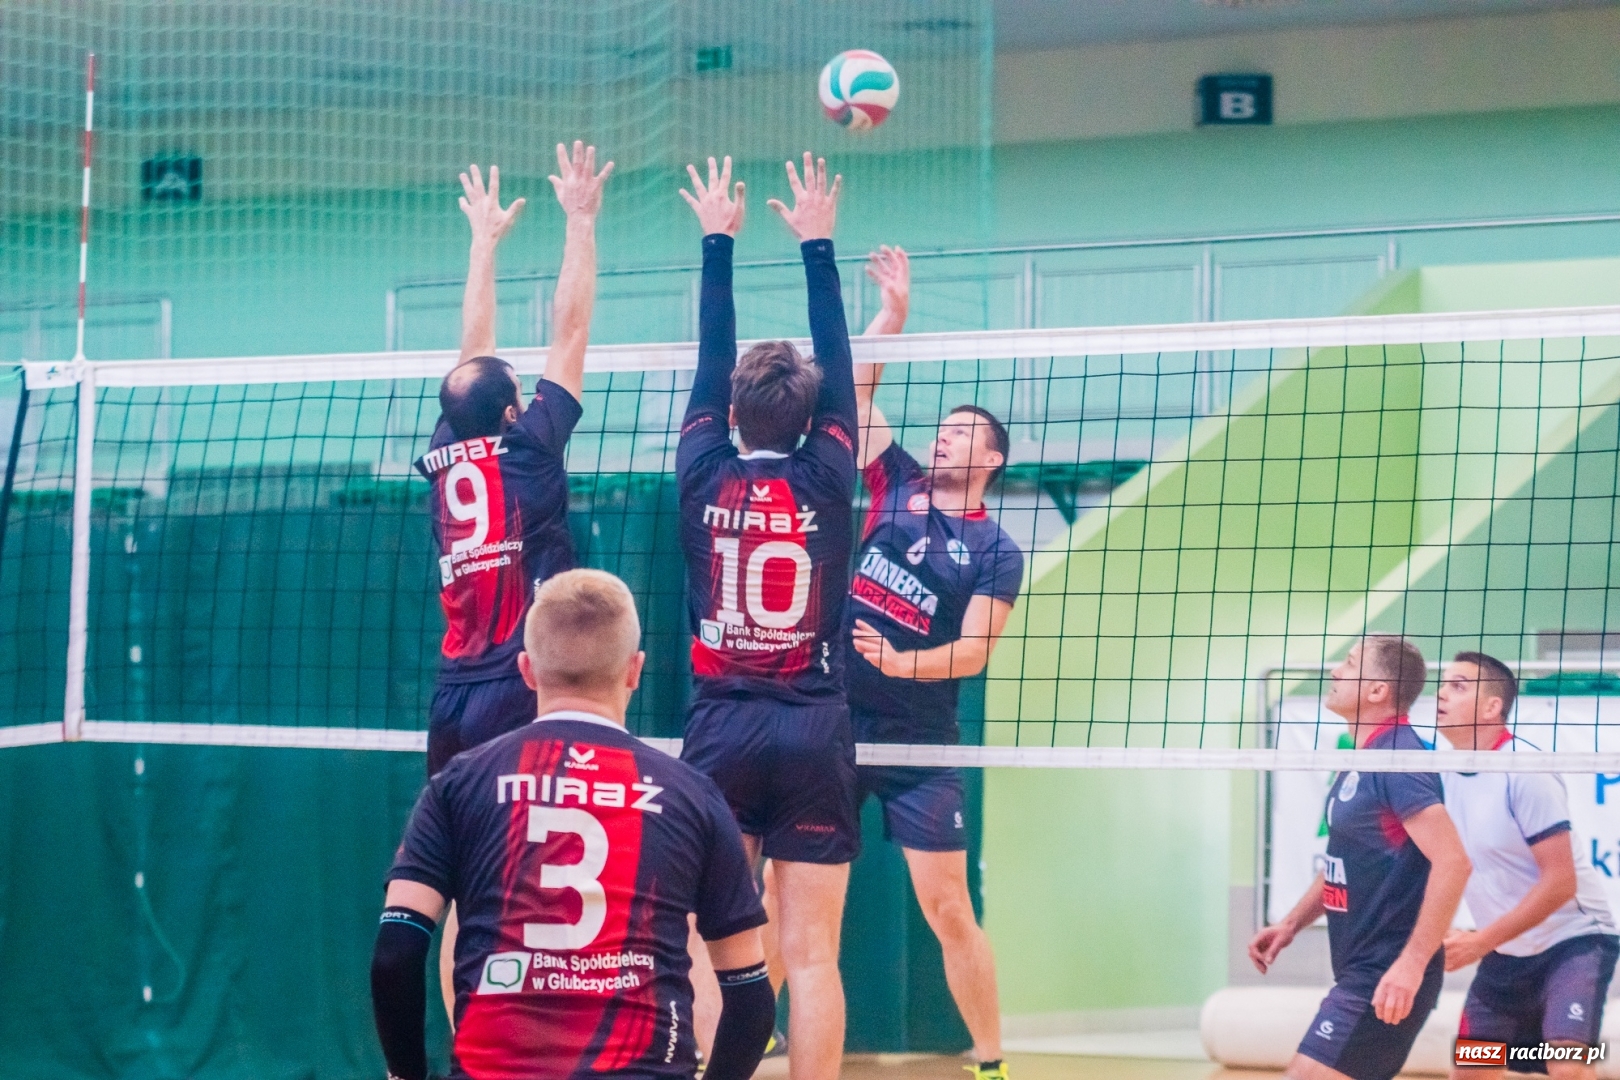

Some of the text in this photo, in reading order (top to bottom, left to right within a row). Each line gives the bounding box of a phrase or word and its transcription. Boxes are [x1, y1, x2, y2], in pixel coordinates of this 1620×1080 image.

[1219, 91, 1255, 119] B
[446, 461, 489, 552] 9
[454, 568, 463, 577] w
[714, 537, 812, 630] 10
[726, 623, 751, 637] Bank
[726, 639, 735, 648] w
[523, 805, 609, 950] 3
[532, 950, 655, 975] Bank Spółdzielczy
[532, 971, 640, 994] w Głubczycach
